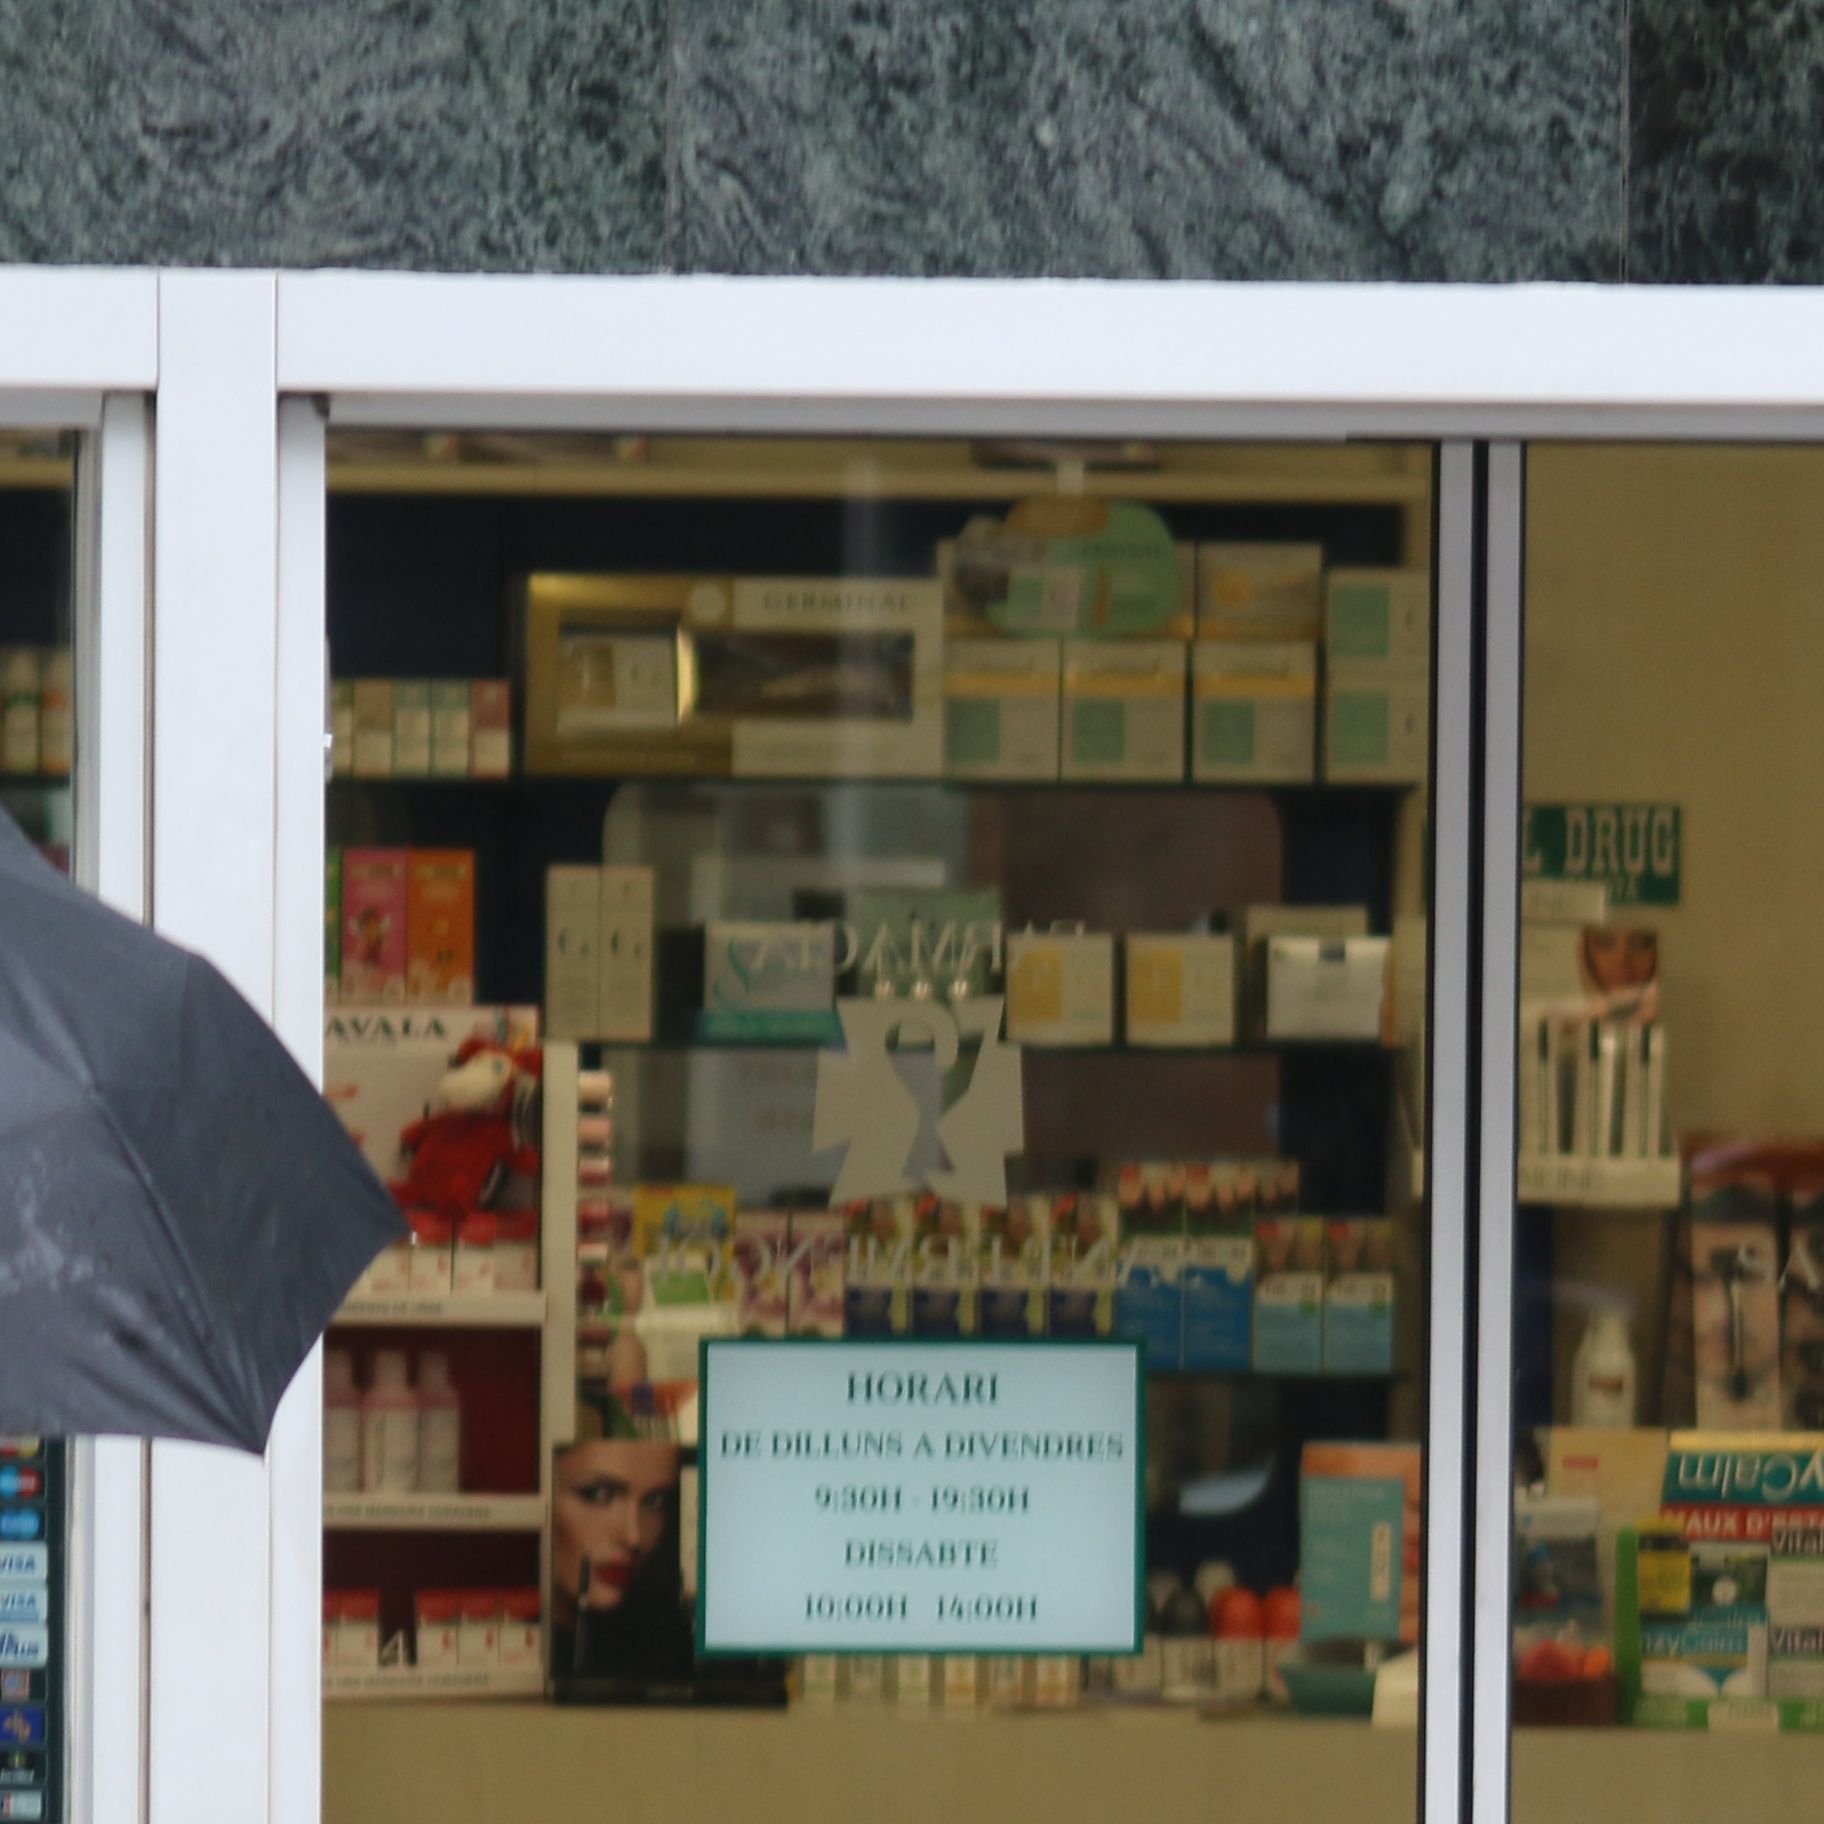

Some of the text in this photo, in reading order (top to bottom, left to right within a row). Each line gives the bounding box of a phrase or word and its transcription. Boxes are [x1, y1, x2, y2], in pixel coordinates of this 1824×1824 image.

[1565, 808, 1674, 884] DRUG
[846, 1370, 1000, 1405] HORARI
[719, 1430, 1125, 1463] DE DILLUNS A DIVENDRES
[843, 1539, 999, 1568] DISSABTE
[803, 1593, 909, 1624] 10:00H
